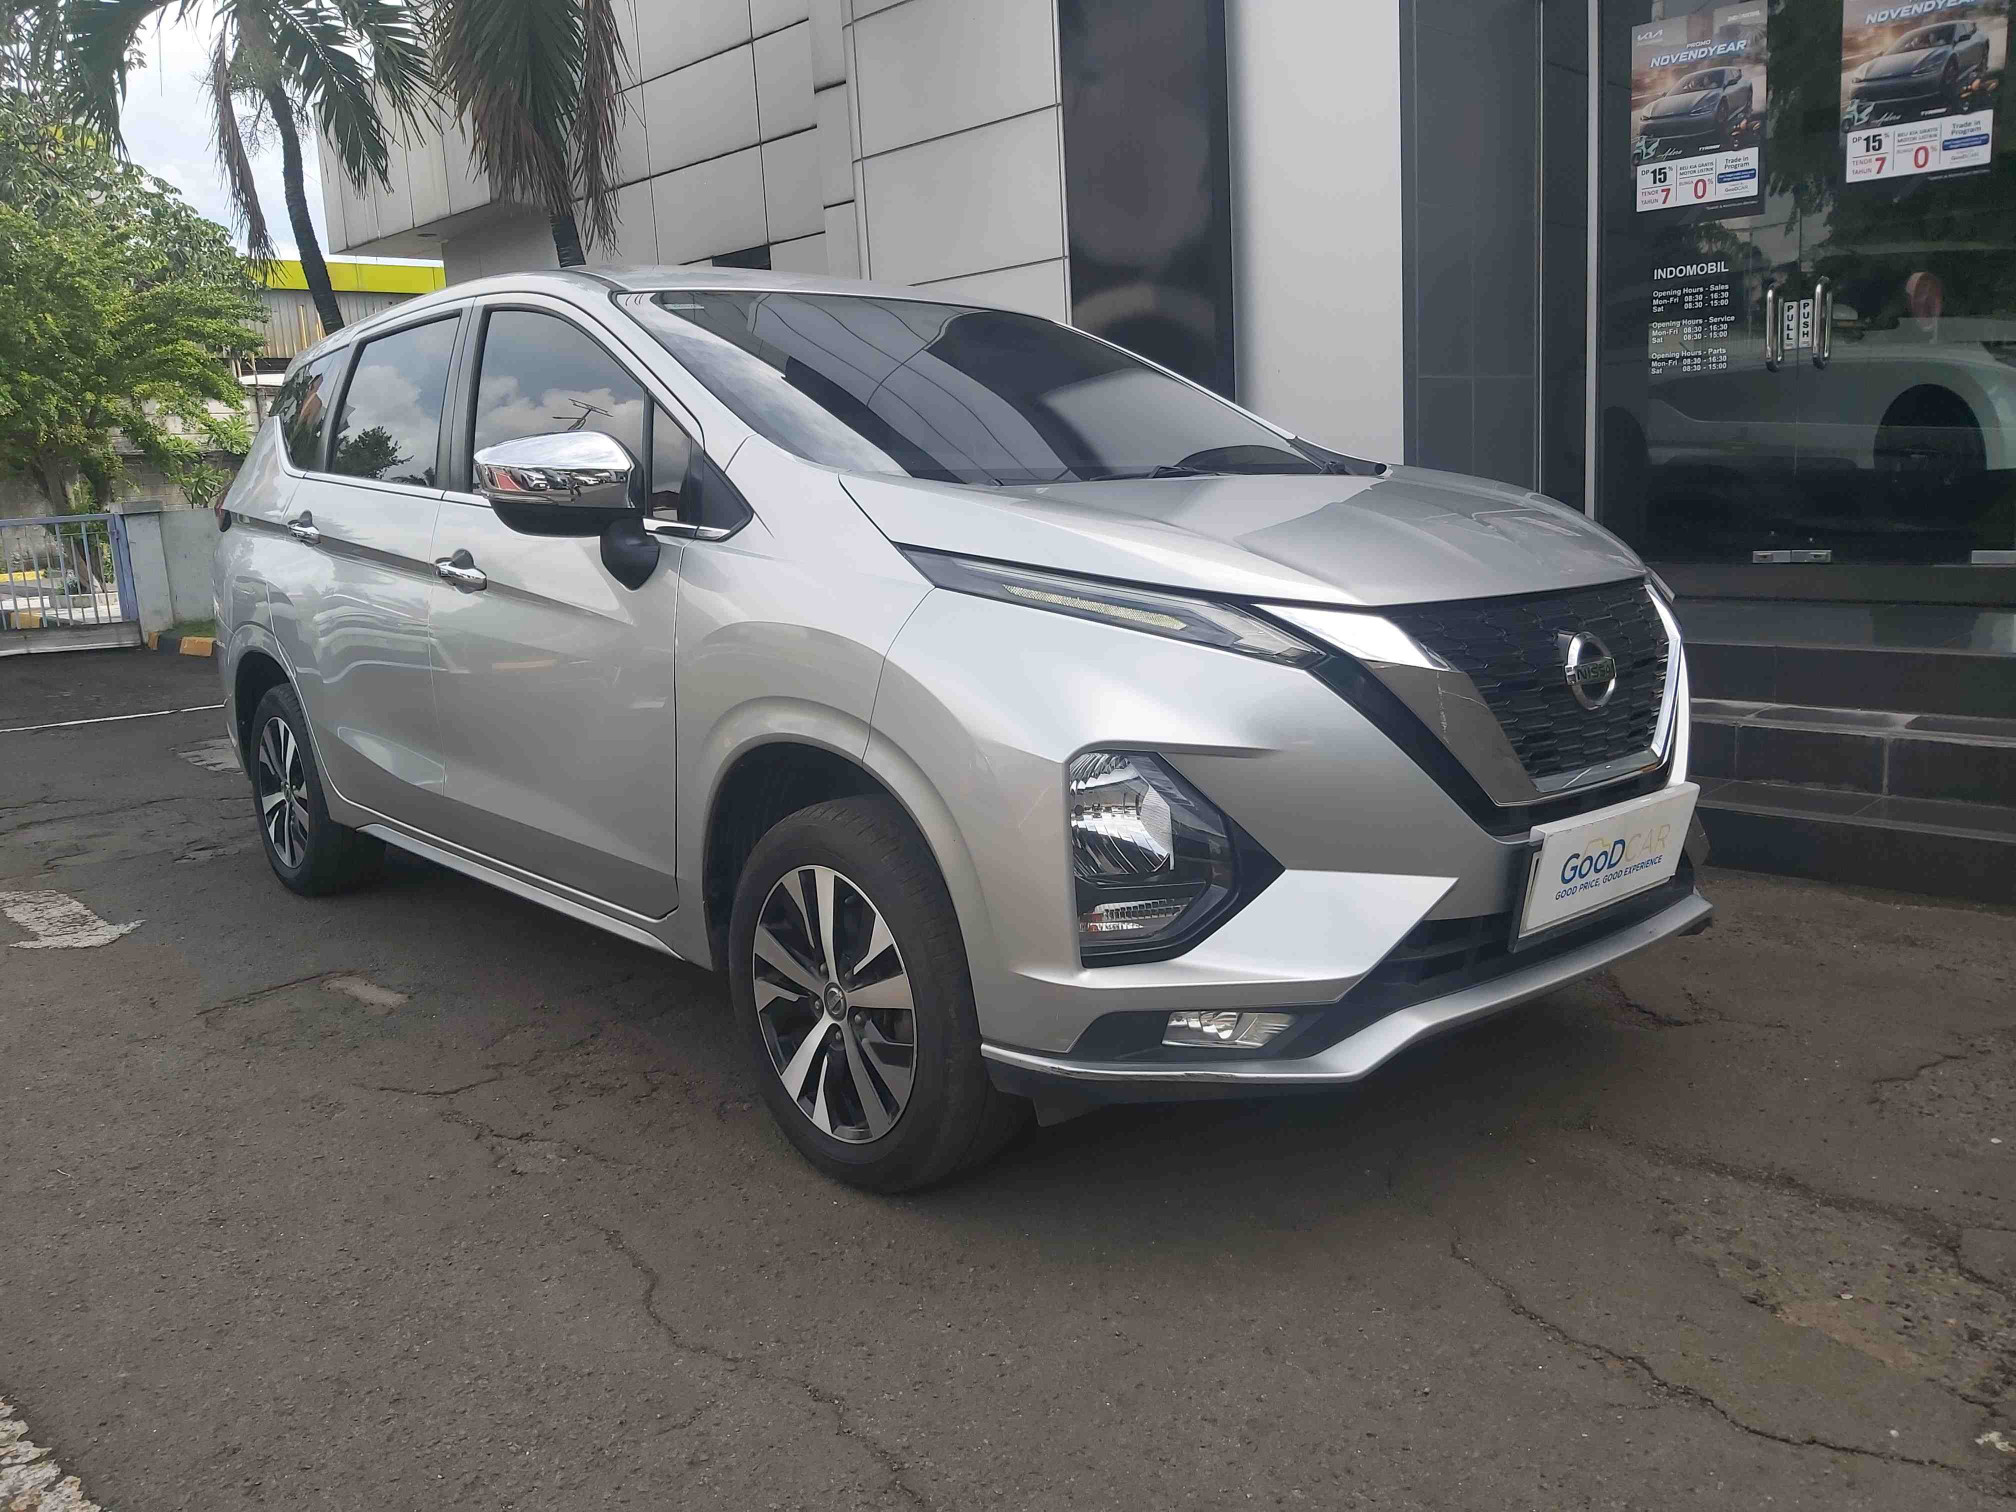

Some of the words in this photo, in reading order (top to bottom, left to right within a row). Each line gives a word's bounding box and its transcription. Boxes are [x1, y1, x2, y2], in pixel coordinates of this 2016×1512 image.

[1865, 0, 1975, 24] NOVENDYEA
[1687, 39, 1712, 49] PROMO
[1650, 40, 1747, 68] NOVENDYEAR
[1952, 121, 1971, 129] Trade
[1951, 126, 1981, 136] Program
[1852, 136, 1862, 144] DP
[1724, 161, 1750, 170] Program
[1852, 157, 1872, 166] TENOR
[1875, 156, 1887, 175] 7
[1852, 167, 1872, 175] TAHUN
[1641, 189, 1659, 197] TENOR
[1660, 187, 1671, 204] 7
[1641, 198, 1659, 206] TAHUN
[1654, 261, 1729, 280] INDOMOBIL
[1653, 289, 1681, 297] Opening
[1652, 320, 1680, 329] Opening
[1709, 315, 1735, 323] Service
[1786, 305, 1794, 340] PULL
[1652, 328, 1678, 336] Mon-Fri
[1684, 326, 1702, 334] 08:30
[1684, 333, 1702, 341] 08:30
[1652, 351, 1679, 359] Opening
[1682, 349, 1702, 357] Hours
[1683, 364, 1701, 372] 08:30
[1709, 362, 1727, 370] 15:00
[1577, 660, 1614, 680] NISSA
[1555, 885, 1577, 901] GOOD
[1579, 877, 1601, 893] PRICE,
[1602, 870, 1623, 884] GOOD
[1624, 855, 1663, 876] EXPERIENCE
